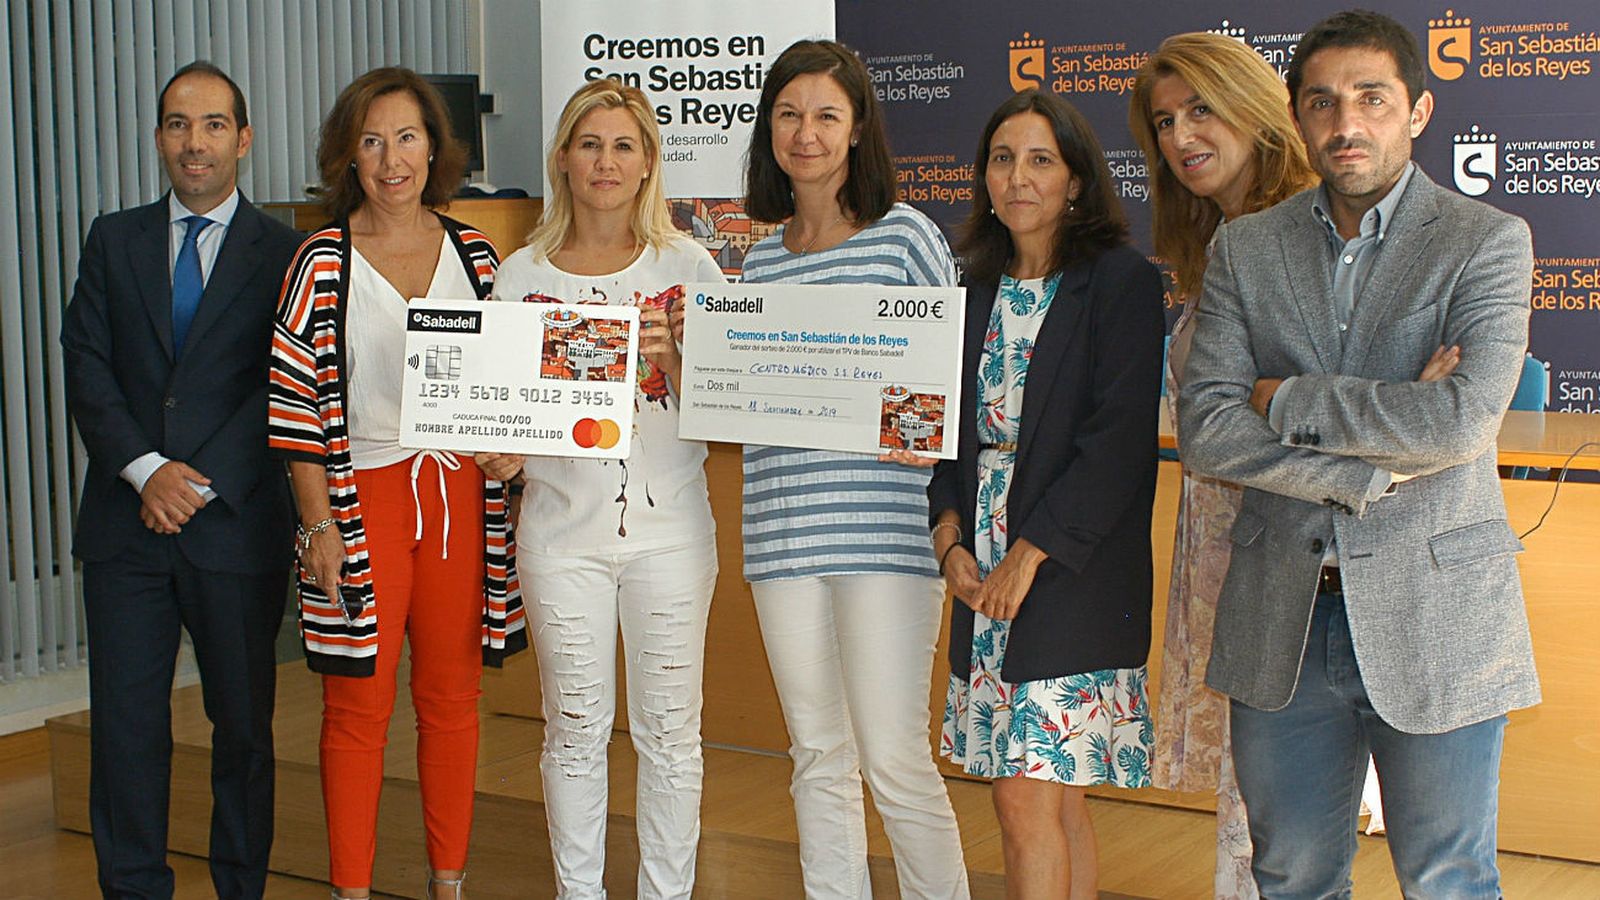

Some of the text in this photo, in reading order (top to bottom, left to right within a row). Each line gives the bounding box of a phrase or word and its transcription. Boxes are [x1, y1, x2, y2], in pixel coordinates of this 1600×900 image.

[1479, 22, 1569, 34] AYUNTAMIENTO DE
[583, 33, 765, 61] Creemos en
[1252, 33, 1305, 43] AYUNTAMIE
[1480, 37, 1514, 56] San
[1052, 42, 1126, 54] AYUNTAMIENTO DE
[866, 53, 934, 64] AYUNTAMIENTO DE
[1052, 51, 1149, 74] San Sebastiá
[647, 63, 769, 92] Sebasti
[867, 62, 964, 83] San Sebastián
[1480, 57, 1591, 80] de los Reyes
[887, 84, 906, 101] los
[909, 83, 950, 104] Reyes
[1052, 74, 1136, 95] de los Reye
[681, 98, 757, 130] Reye
[666, 134, 728, 146] desarrollo
[1504, 140, 1595, 151] AYUNTAMIENTO DE
[662, 150, 697, 162] udad.
[946, 154, 956, 163] DE
[1505, 151, 1600, 172] San Sebas
[896, 164, 975, 182] an Sebastiá
[1122, 181, 1150, 202] Rey
[1505, 174, 1530, 194] de
[1532, 174, 1558, 194] los
[897, 184, 973, 205] e los Reyes
[1533, 269, 1567, 288] San
[705, 296, 763, 313] Sabadell
[1532, 290, 1557, 310] de
[1560, 290, 1585, 310] los
[421, 314, 477, 329] Sabadell
[727, 328, 909, 349] Creemos en San Sebastián de los Reyes
[1559, 370, 1600, 380] AYUNTA
[418, 383, 614, 406] 1234 5678 9012 3456
[707, 379, 725, 391] Dos
[726, 380, 739, 391] mil
[1560, 382, 1594, 401] San
[452, 413, 479, 421] CADUCA
[499, 414, 532, 425] 00/00
[459, 425, 508, 437] APELLIDO
[512, 428, 563, 440] APELLIDO
